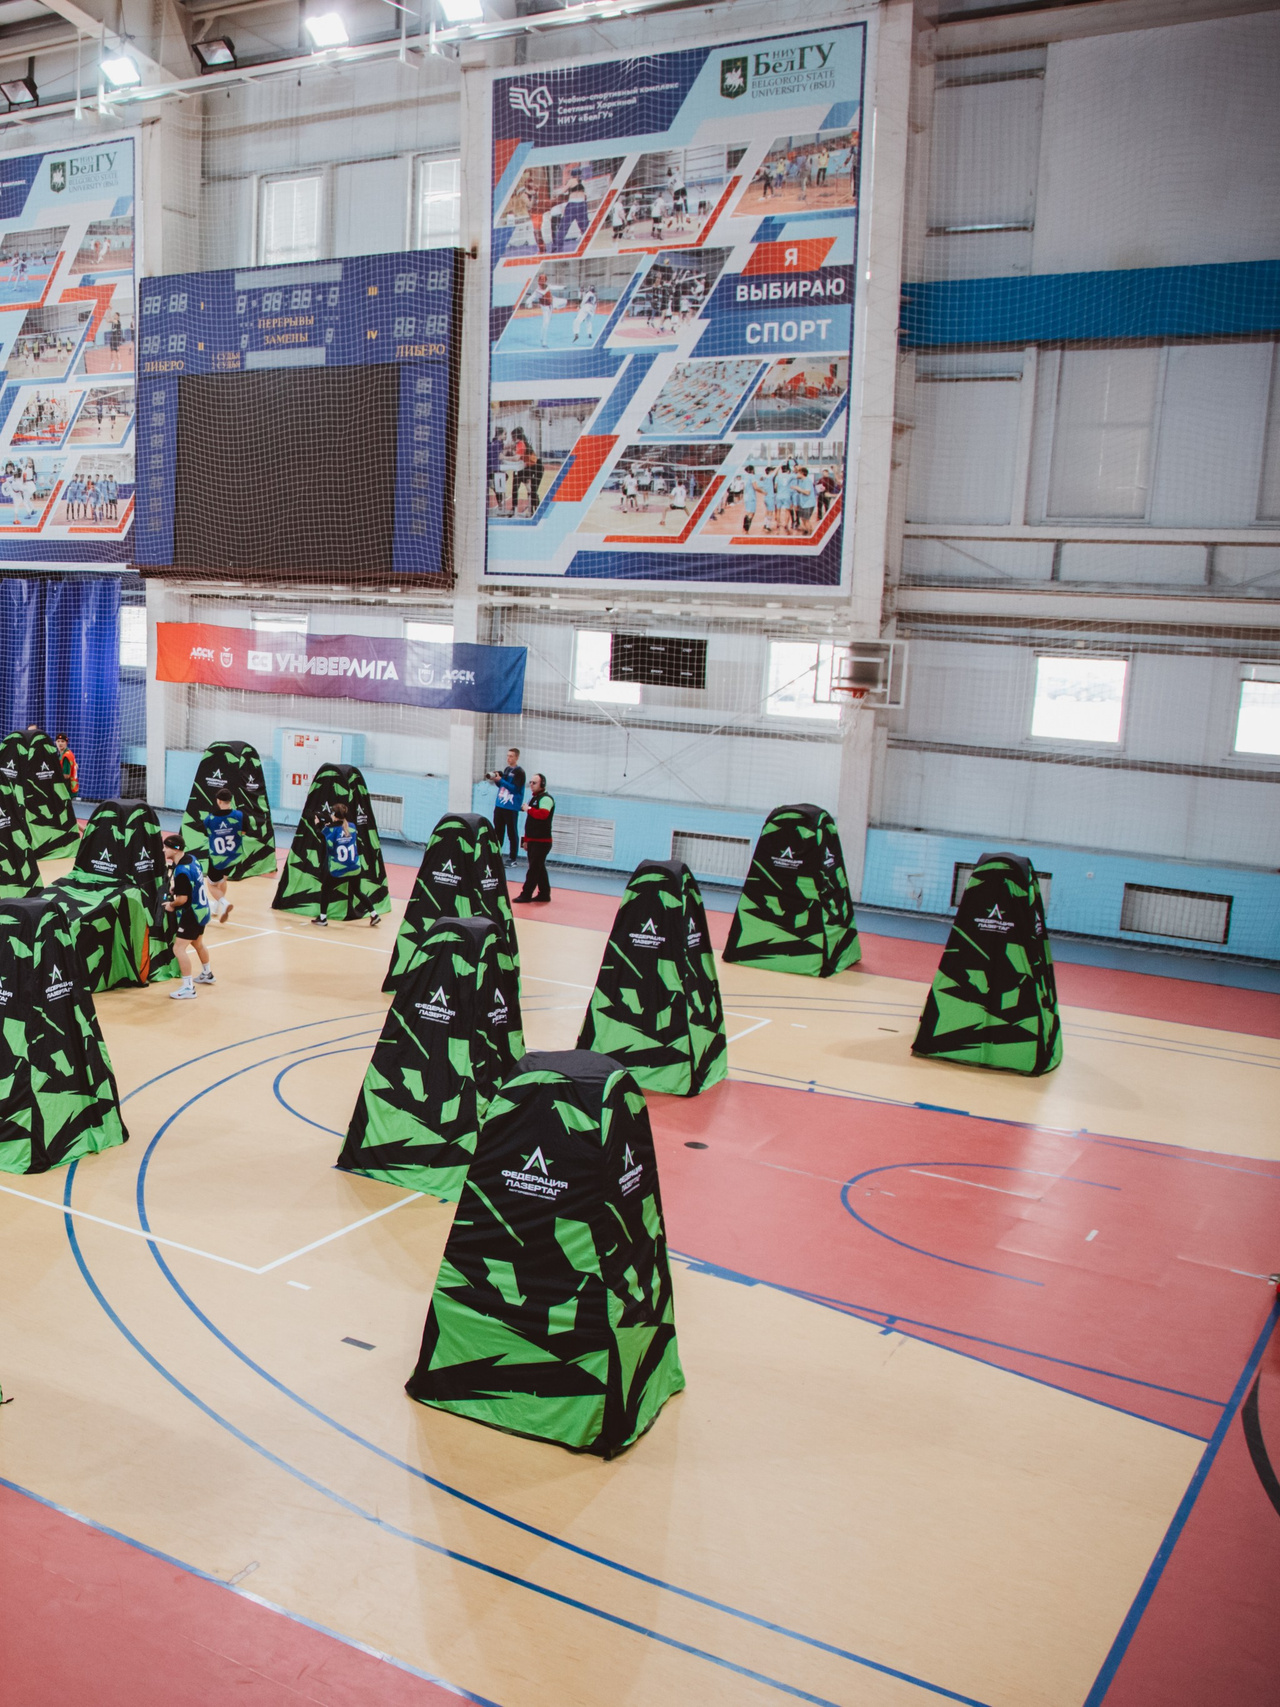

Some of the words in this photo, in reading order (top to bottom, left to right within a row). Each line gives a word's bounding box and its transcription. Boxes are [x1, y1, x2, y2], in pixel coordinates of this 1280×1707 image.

[753, 42, 836, 76] БелГУ
[752, 75, 805, 89] BELGOROD
[806, 70, 835, 81] STATE
[752, 84, 807, 99] UNIVERSITY
[69, 151, 118, 177] БелГУ
[784, 247, 798, 266] Я
[736, 278, 845, 301] ВЫБИРАЮ
[258, 315, 314, 329] ПЕРЕРЫВЫ
[746, 319, 832, 344] СПОРТ
[264, 333, 308, 344] ЗАМЕНЫ
[395, 343, 446, 358] ЛИБЕРО
[144, 360, 184, 372] ЛИБЕРО
[275, 653, 399, 680] УНИВЕРЛИГА
[214, 835, 236, 854] 03
[337, 844, 355, 862] 01
[501, 1170, 568, 1189] ФЕДЕРАЦИЯ
[505, 1179, 561, 1196] ЛАЗЕРТАГ
